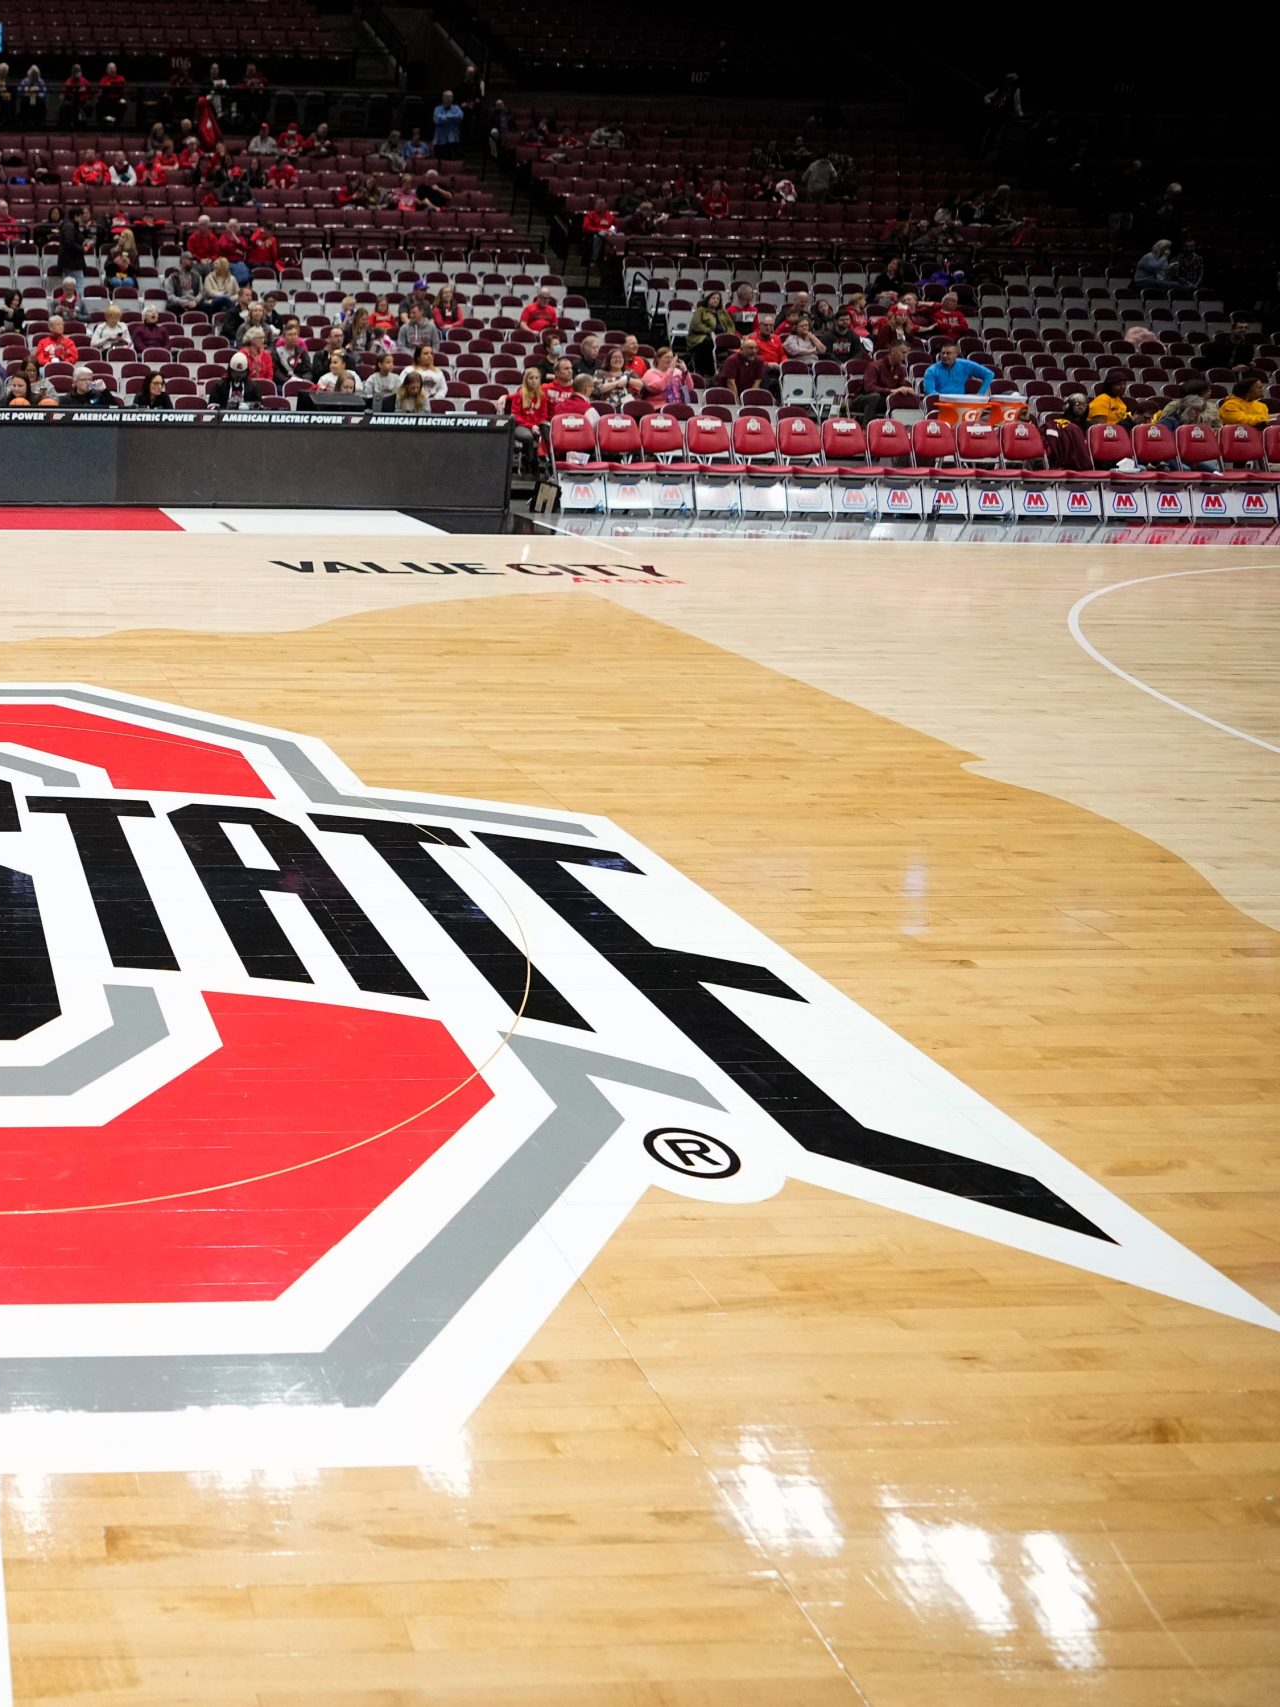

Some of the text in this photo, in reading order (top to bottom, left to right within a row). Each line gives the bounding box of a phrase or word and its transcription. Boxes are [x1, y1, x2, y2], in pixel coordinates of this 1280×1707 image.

[170, 56, 191, 69] 106
[688, 71, 710, 83] 107
[11, 412, 45, 420] POWER
[72, 413, 195, 421] AMERICAN ELECTRIC POWER
[222, 413, 343, 424] AMERICAN ELECTRIC POWER
[369, 416, 489, 427] AMERICAN ELECTRIC POWER
[982, 493, 1000, 505] M
[1026, 494, 1045, 506] M
[1071, 494, 1088, 507] M
[1116, 495, 1134, 507] M
[1160, 495, 1178, 508] M
[1205, 495, 1223, 508] M
[1246, 495, 1264, 508] M
[268, 560, 669, 578] VALUE CITY
[572, 577, 687, 585] Arena
